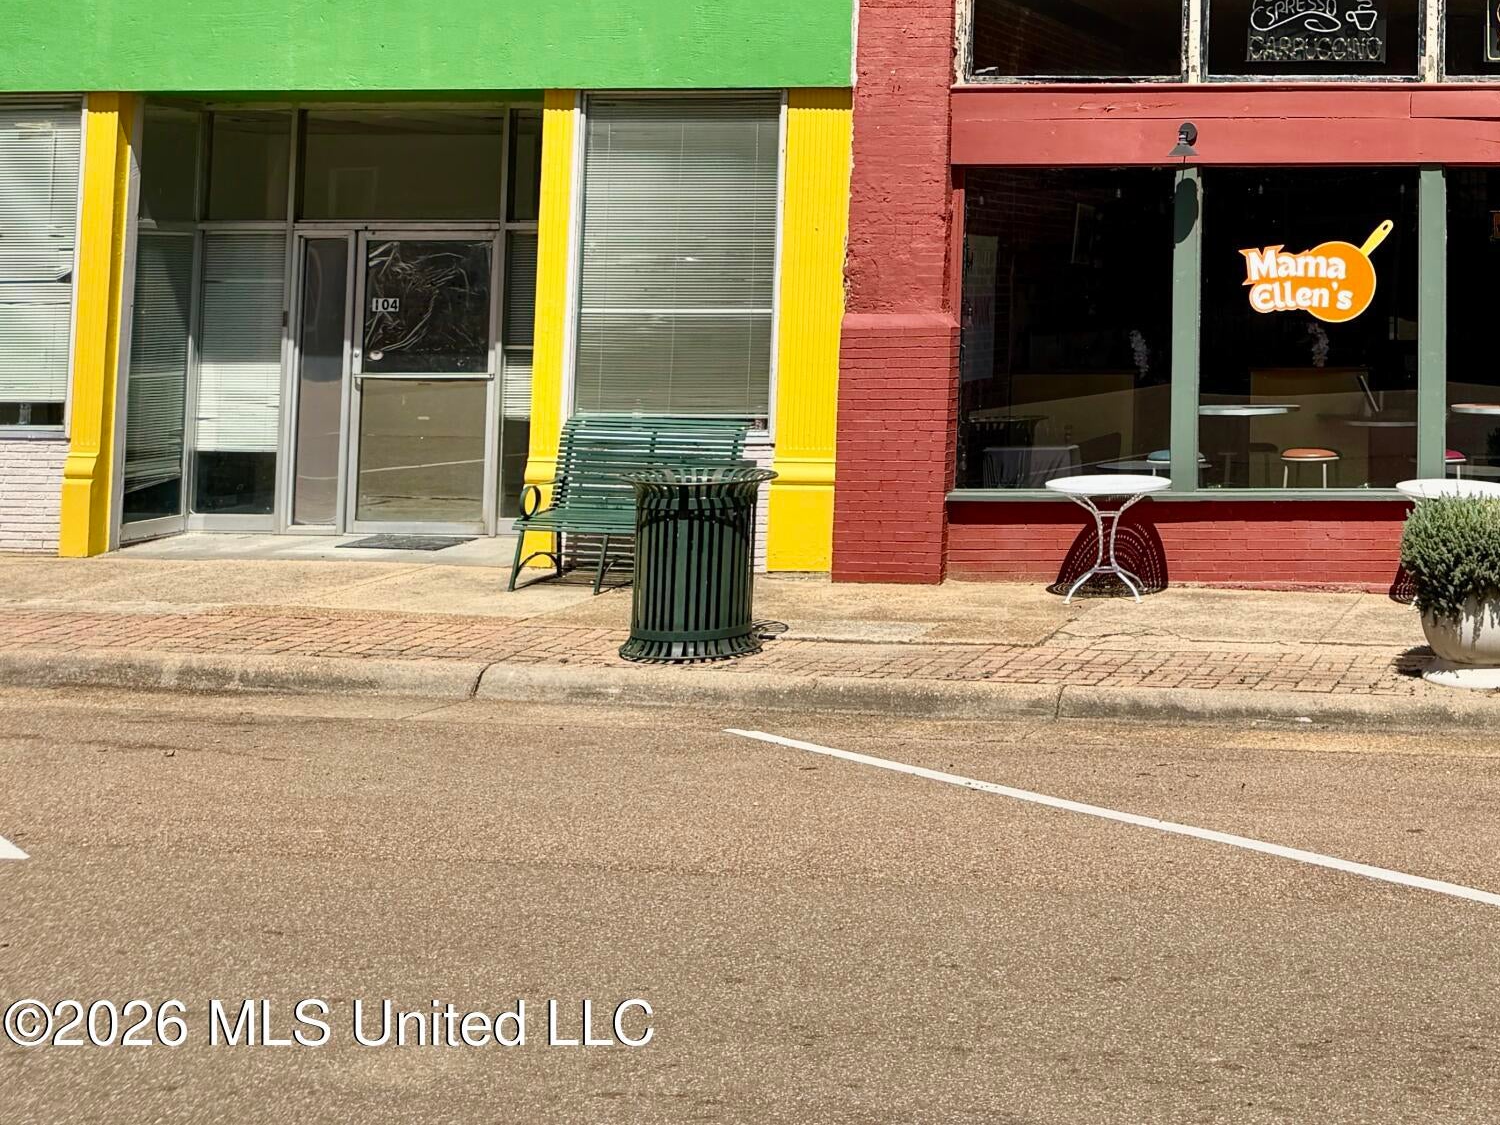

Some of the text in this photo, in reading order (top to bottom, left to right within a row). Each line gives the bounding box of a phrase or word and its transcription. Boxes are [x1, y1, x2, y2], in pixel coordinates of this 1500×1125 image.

[1248, 250, 1346, 280] Mama
[375, 299, 398, 311] 104
[1252, 281, 1354, 310] Ellen's
